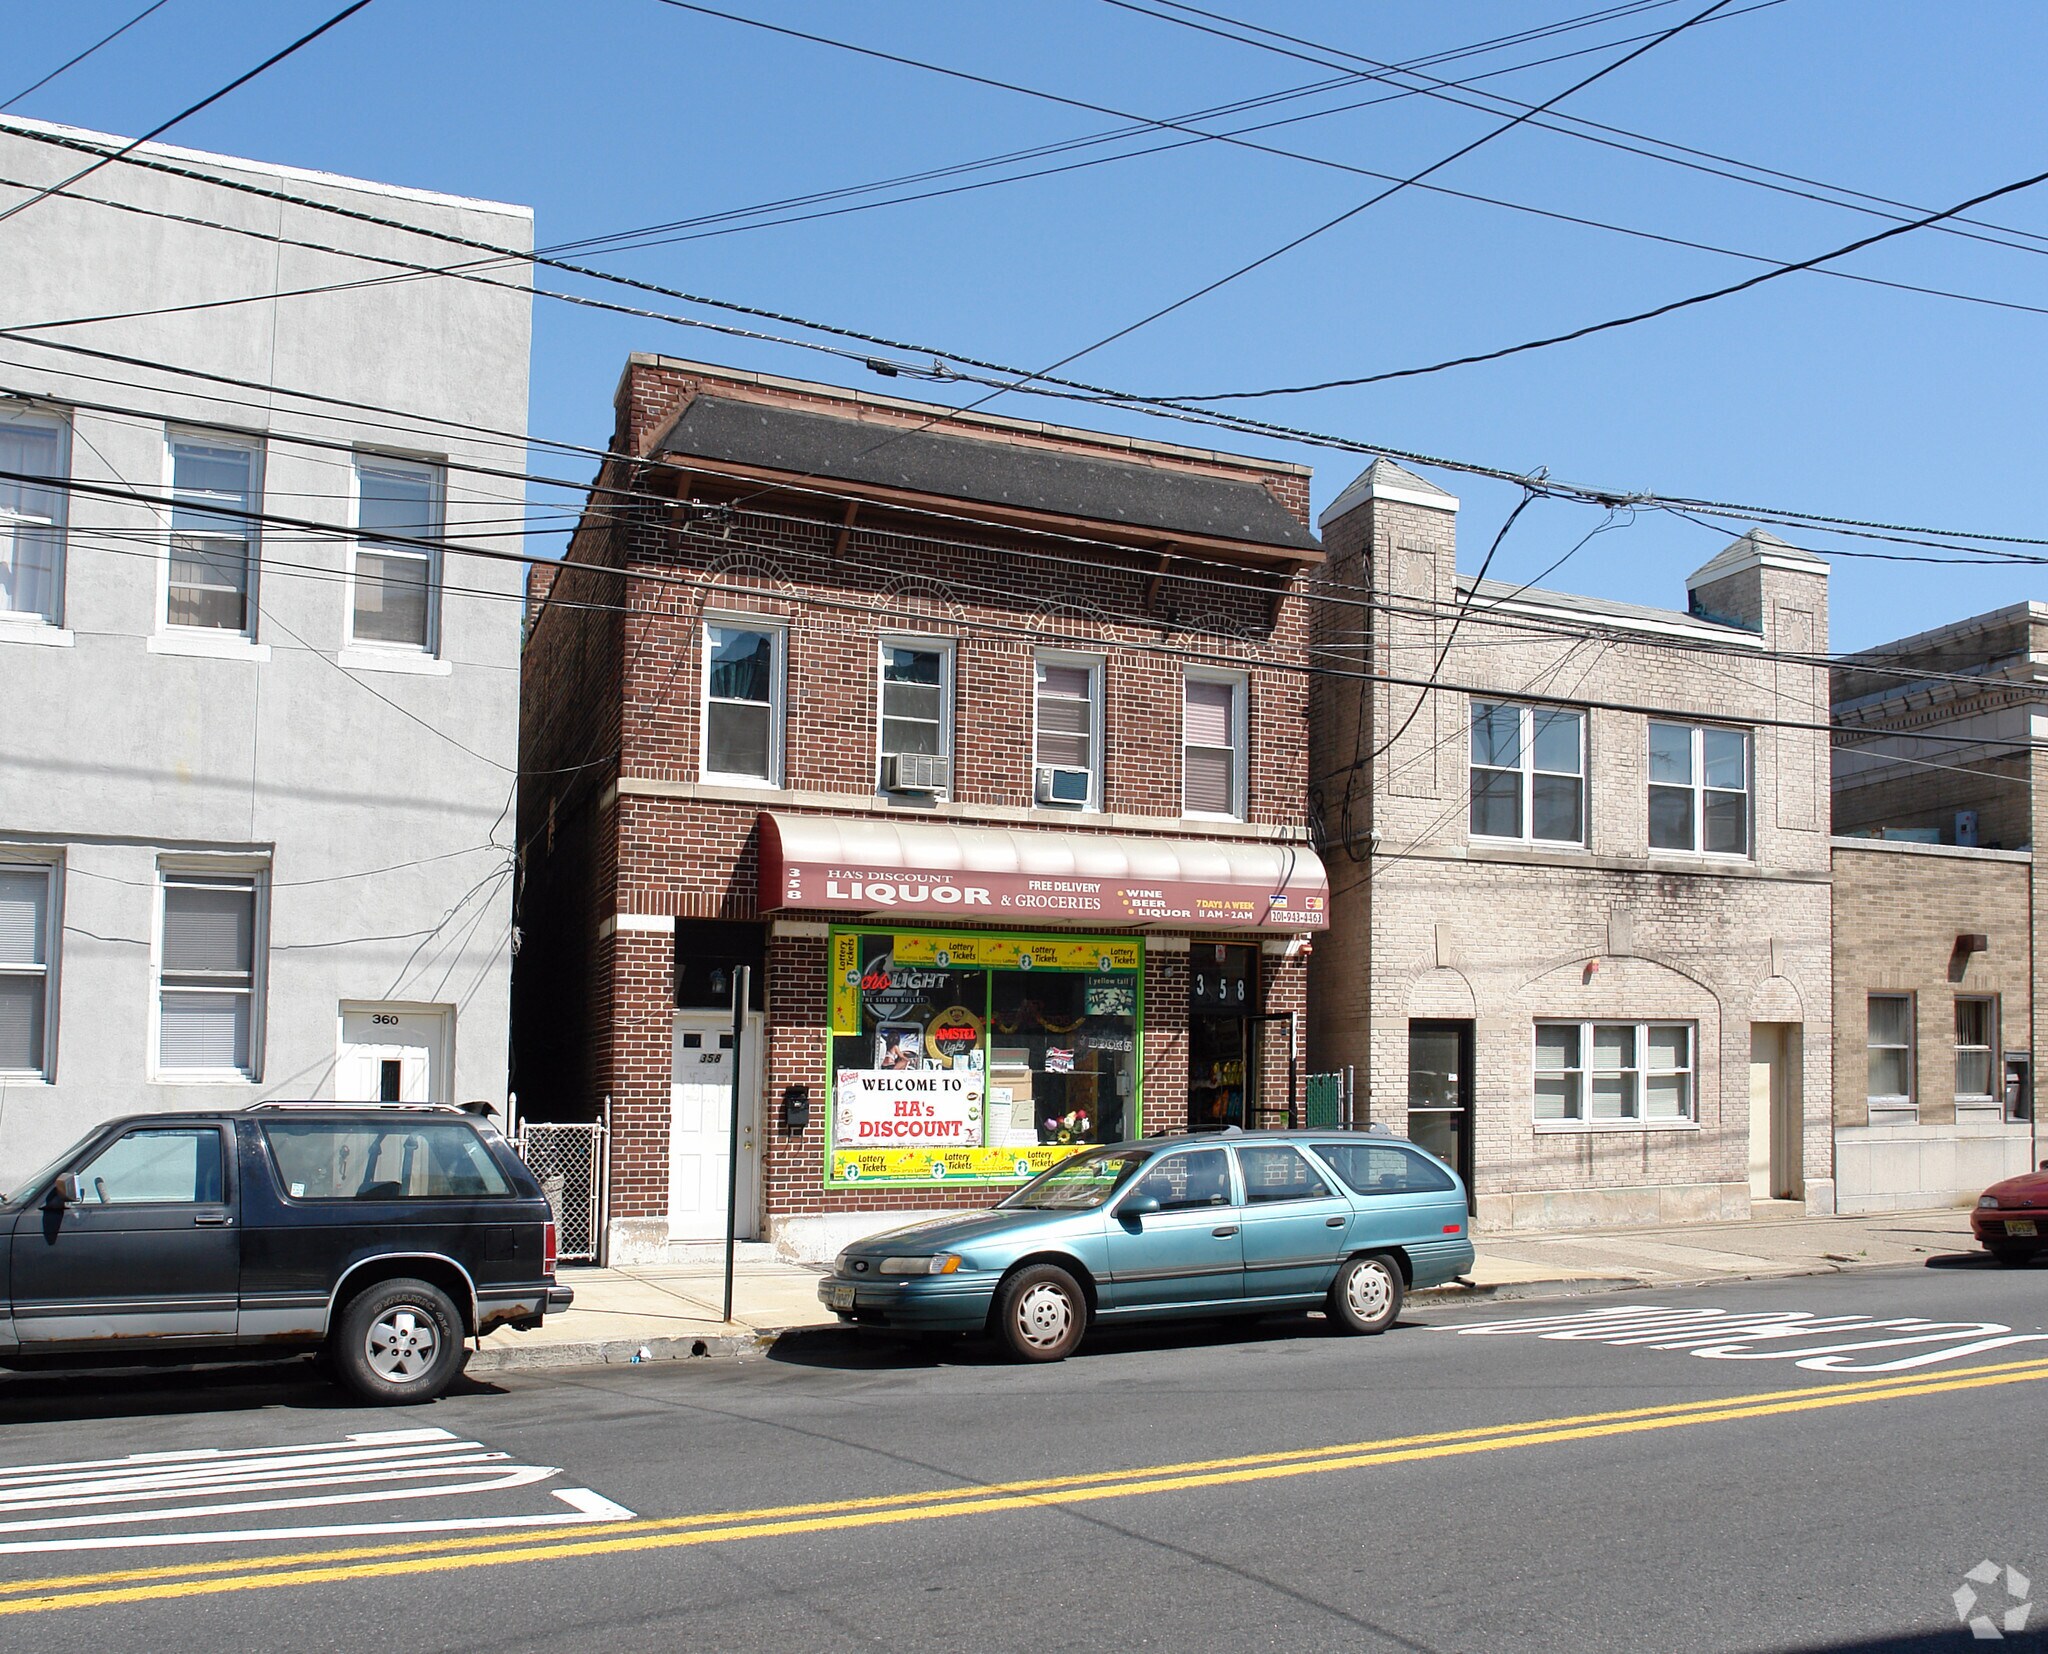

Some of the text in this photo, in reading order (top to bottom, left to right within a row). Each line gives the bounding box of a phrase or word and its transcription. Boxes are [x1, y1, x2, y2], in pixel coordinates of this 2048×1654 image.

[828, 869, 953, 884] HA'S DISCOUNT
[1028, 880, 1101, 893] FREE DELIVERY
[826, 880, 992, 905] LIQUOR
[1126, 889, 1163, 898] WINE
[1000, 894, 1101, 910] & GROCERIES
[1132, 899, 1167, 908] BEER
[1196, 899, 1255, 910] 7 DAYS A WEEK
[1138, 908, 1191, 918] LIQUOR
[1206, 910, 1223, 919] AM
[949, 942, 975, 952] Lottery
[1031, 945, 1056, 955] Lottery
[1110, 947, 1134, 957] Lottery
[838, 940, 847, 971] Lottery
[847, 938, 855, 967] Tickets
[952, 951, 976, 960] Tickets
[1035, 954, 1058, 963] Tickets
[1114, 956, 1136, 965] Tickets
[861, 971, 950, 990] ors LIGHT
[1093, 977, 1115, 986] yellow
[1117, 977, 1129, 985] tail
[372, 1014, 399, 1026] 360
[935, 1027, 977, 1040] AMSTEL
[699, 1053, 723, 1064] 358
[862, 1078, 937, 1091] WELCOME
[942, 1078, 962, 1091] TO
[894, 1101, 935, 1117] HA's
[858, 1120, 963, 1137] DISCOUNT
[858, 1155, 885, 1164] Lottery
[944, 1153, 971, 1163] Lottery
[1027, 1150, 1053, 1160] Lottery
[862, 1163, 887, 1172] Tickets
[948, 1161, 972, 1170] Tickets
[1031, 1158, 1054, 1167] Tickets
